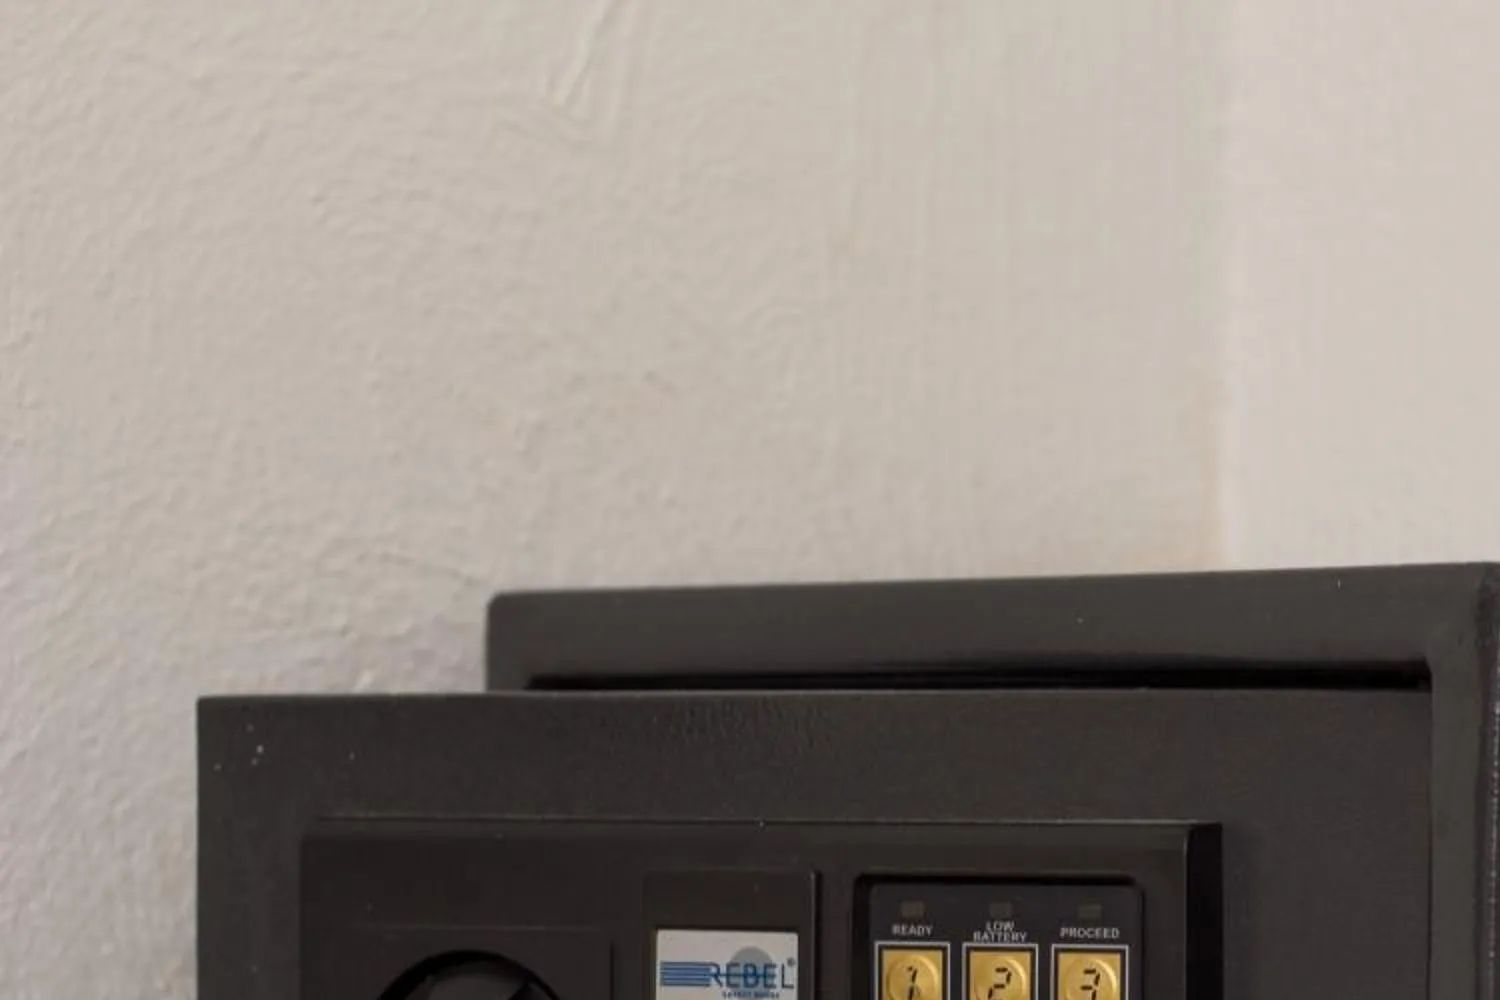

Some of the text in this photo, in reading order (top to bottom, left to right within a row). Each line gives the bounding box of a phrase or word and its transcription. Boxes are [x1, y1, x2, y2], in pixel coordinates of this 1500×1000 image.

[891, 924, 933, 936] READY
[985, 920, 1015, 932] LOW
[973, 931, 1027, 943] BATTERY
[1059, 927, 1120, 939] PROCEED
[706, 961, 794, 989] REBEL
